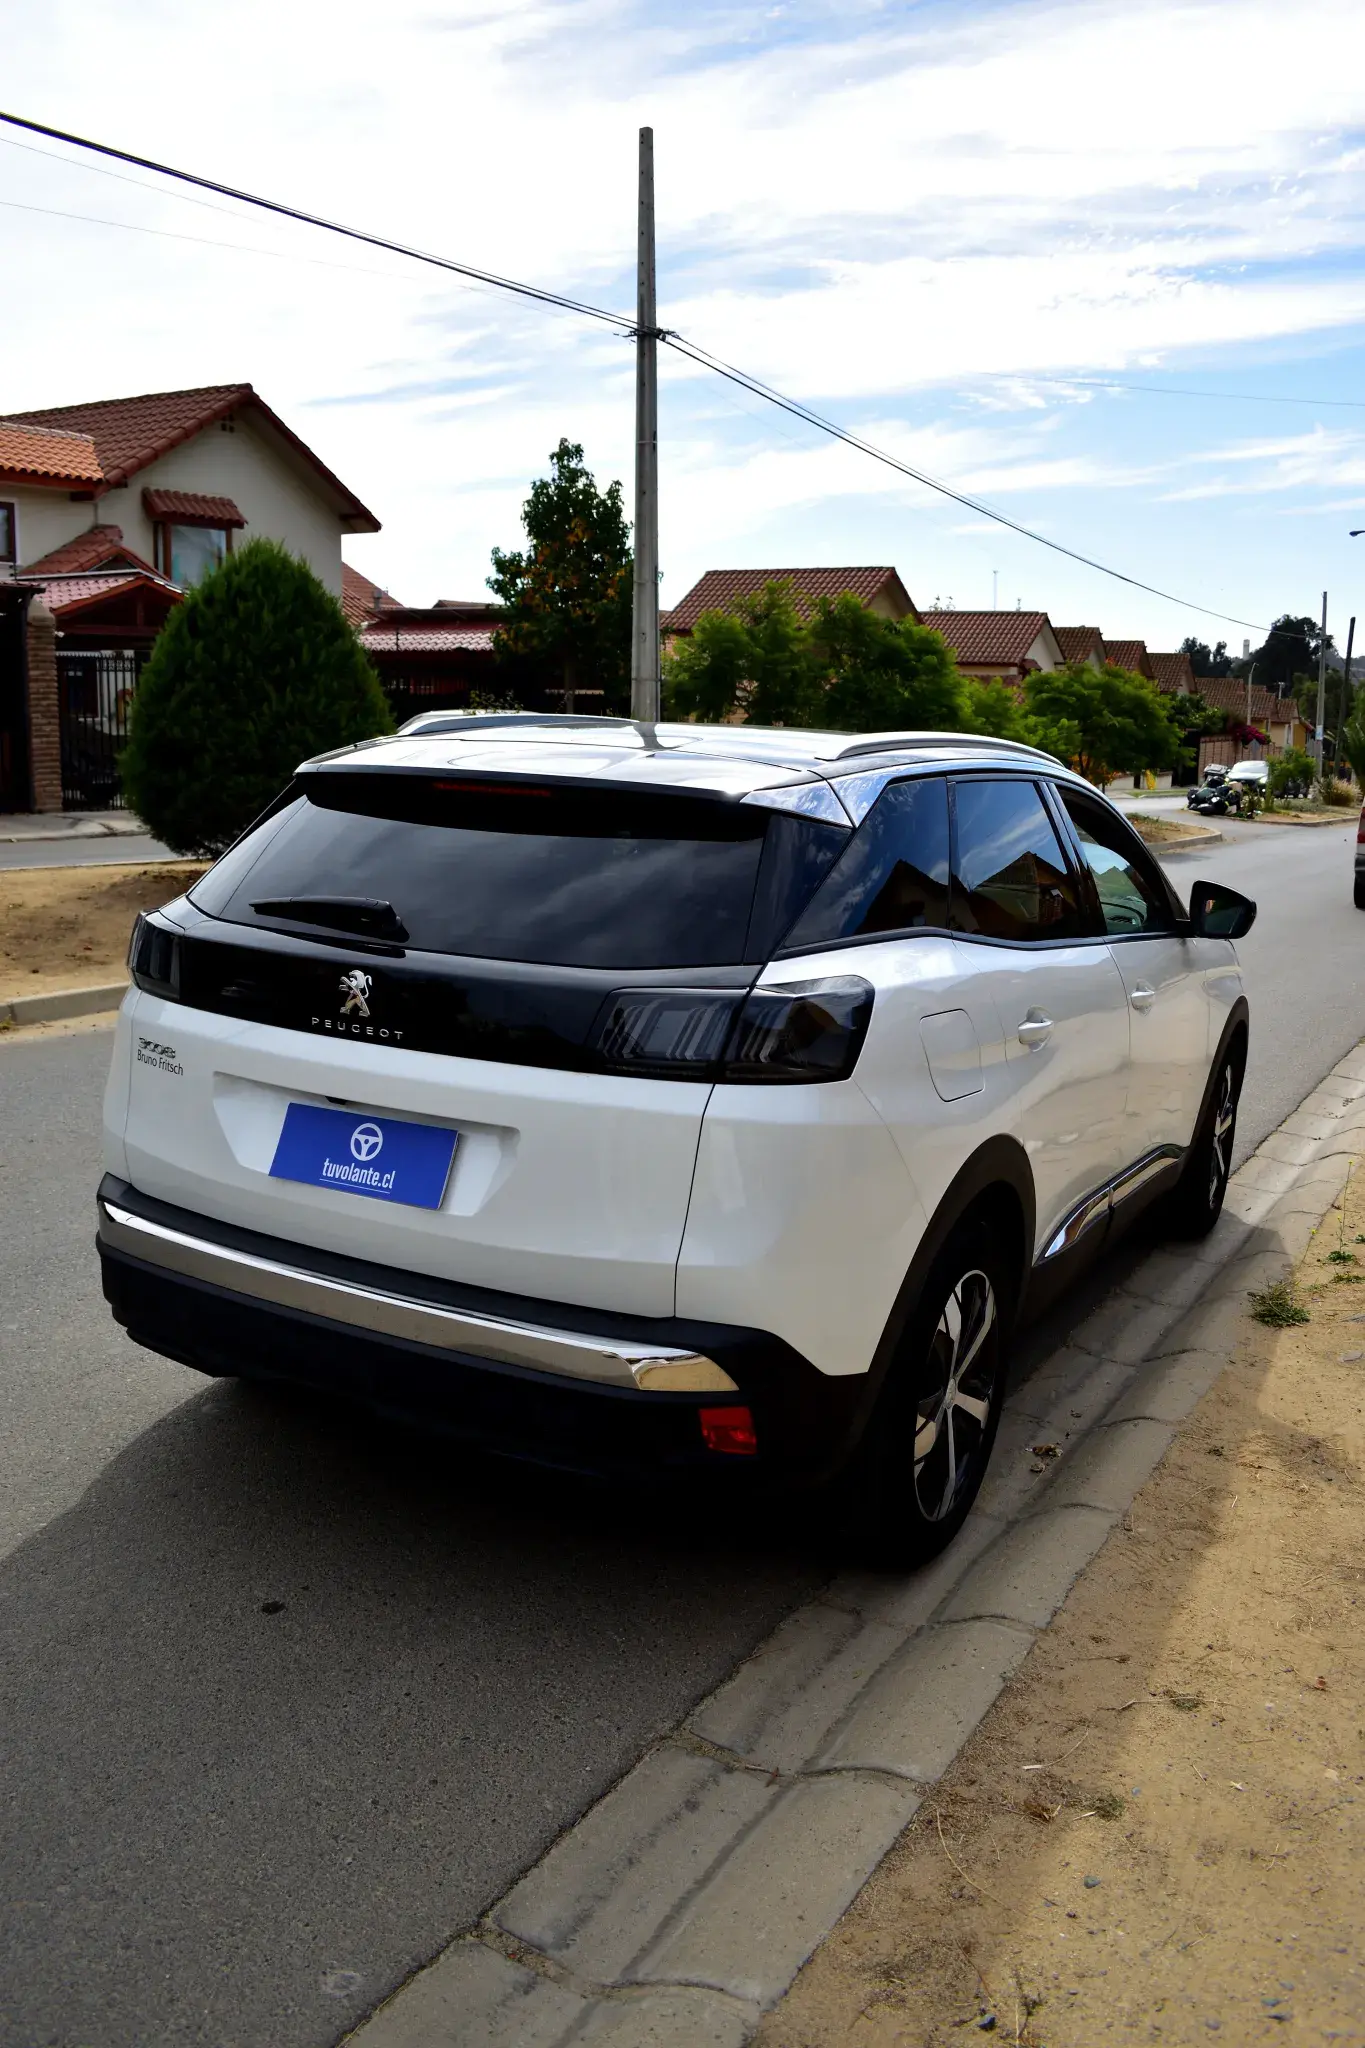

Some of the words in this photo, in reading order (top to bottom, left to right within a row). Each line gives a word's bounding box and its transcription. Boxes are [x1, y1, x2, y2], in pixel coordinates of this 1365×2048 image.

[311, 1017, 403, 1040] PEUGEOT
[138, 1037, 176, 1059] 3008
[137, 1048, 158, 1067] Bruno
[158, 1056, 184, 1076] Fritsch
[322, 1158, 396, 1189] tuvolante.cl
